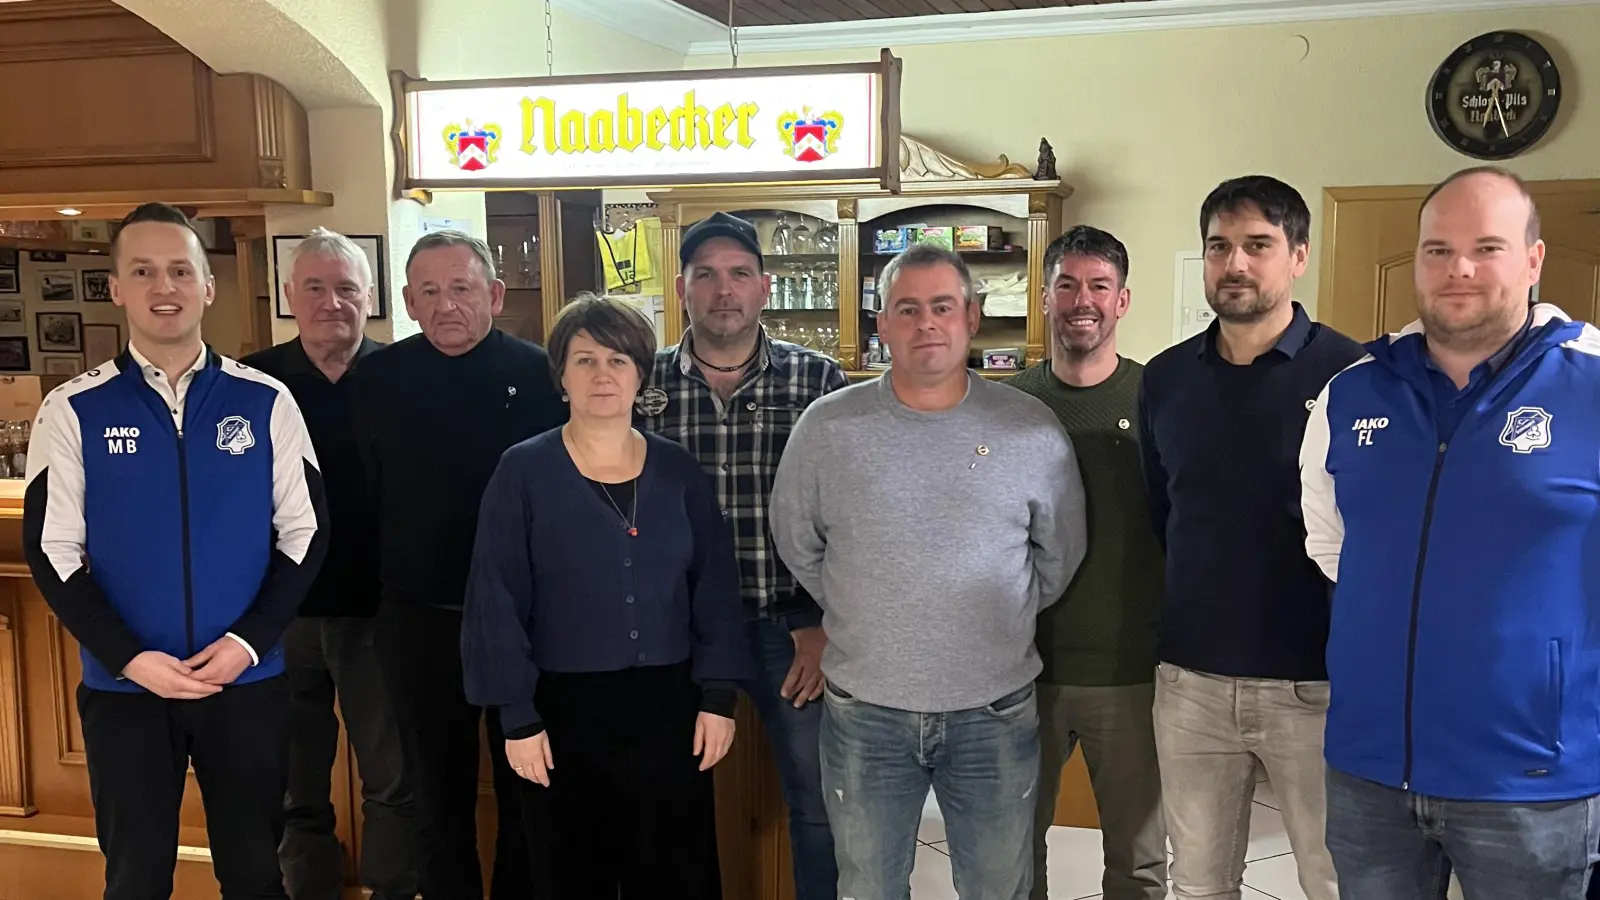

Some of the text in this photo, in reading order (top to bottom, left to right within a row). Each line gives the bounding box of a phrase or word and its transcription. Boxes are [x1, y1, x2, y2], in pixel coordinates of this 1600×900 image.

[518, 88, 759, 156] Naabecker
[1351, 417, 1389, 430] JAKO
[103, 427, 140, 437] JAKO
[1357, 430, 1373, 446] FL
